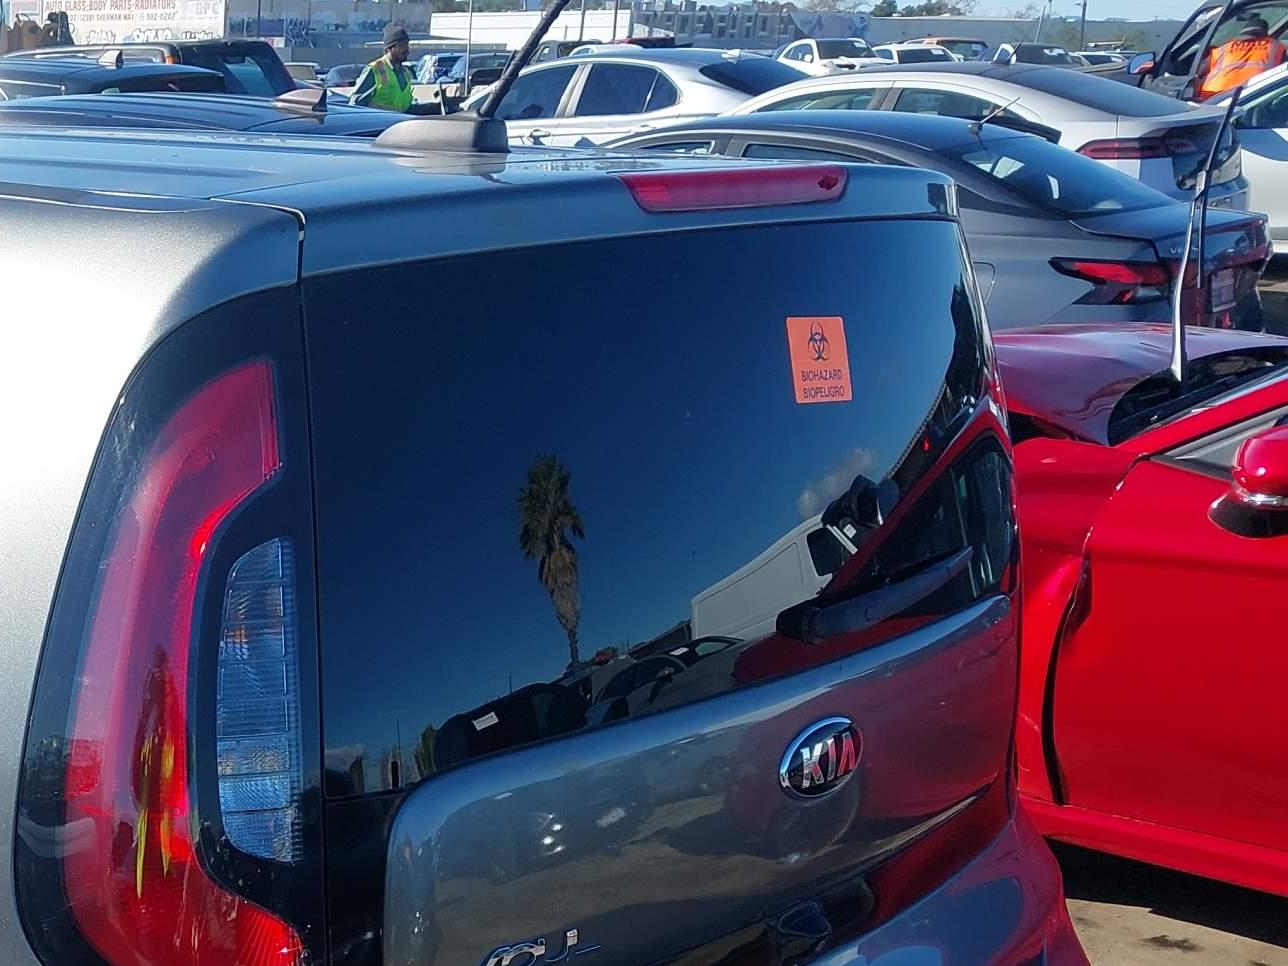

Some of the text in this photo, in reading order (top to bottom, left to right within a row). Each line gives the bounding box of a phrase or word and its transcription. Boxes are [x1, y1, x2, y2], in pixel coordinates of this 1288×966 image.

[96, 13, 122, 21] SHERMAN
[122, 13, 135, 21] WAY
[801, 368, 843, 381] BIOHAZARD
[803, 385, 845, 399] BIOPELIGRO
[800, 731, 856, 789] KIA
